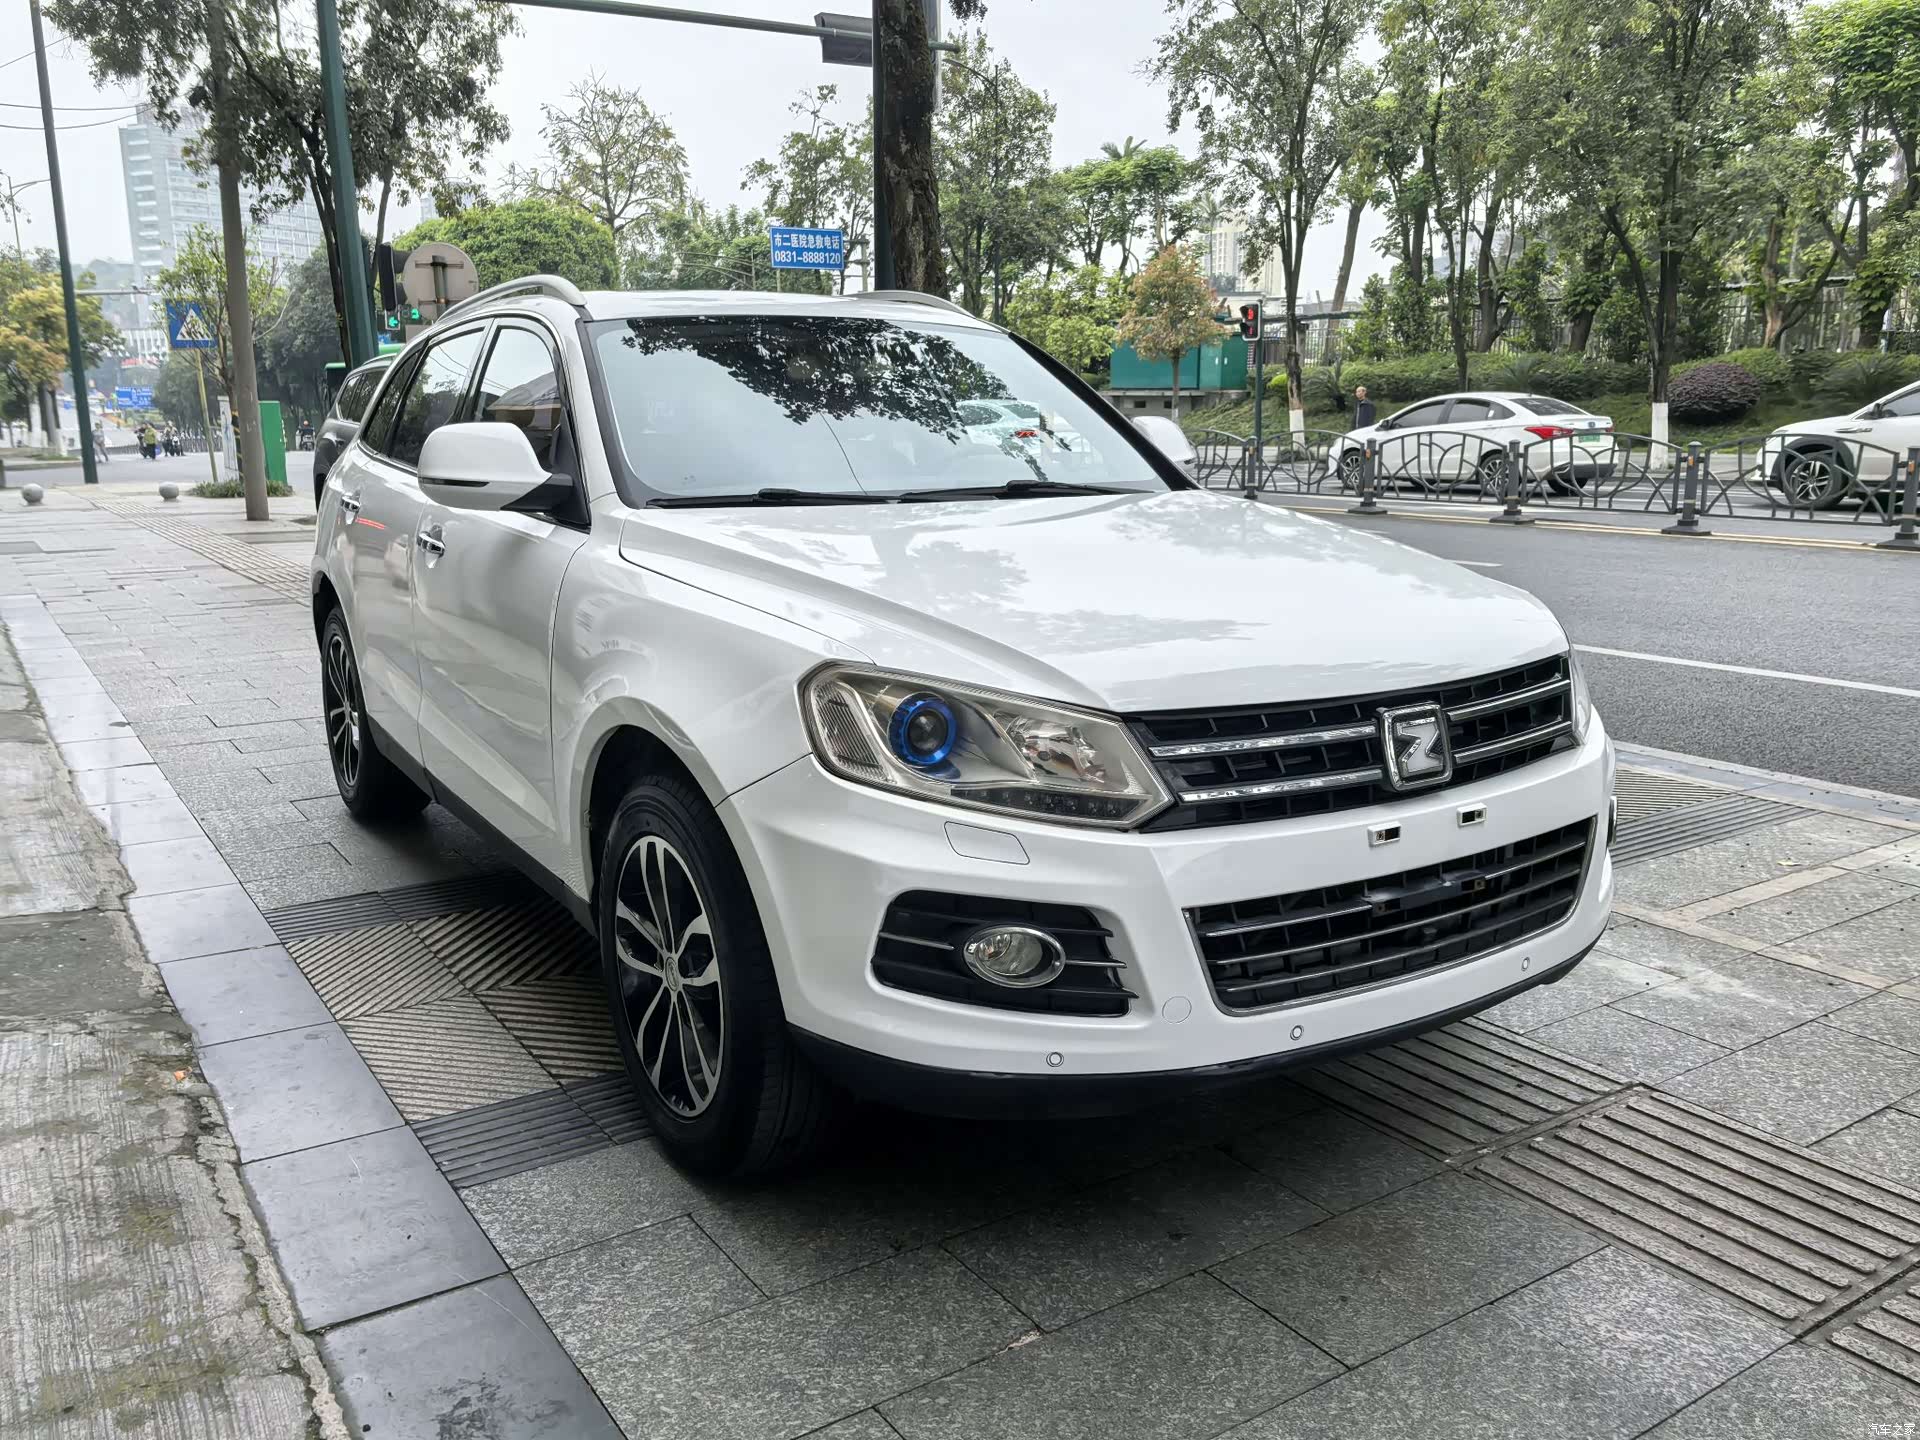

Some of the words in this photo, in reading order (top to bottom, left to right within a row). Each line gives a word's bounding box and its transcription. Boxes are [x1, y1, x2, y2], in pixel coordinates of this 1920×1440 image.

[774, 232, 840, 249] 市二医院急救电话
[774, 251, 841, 264] 0831-8888120
